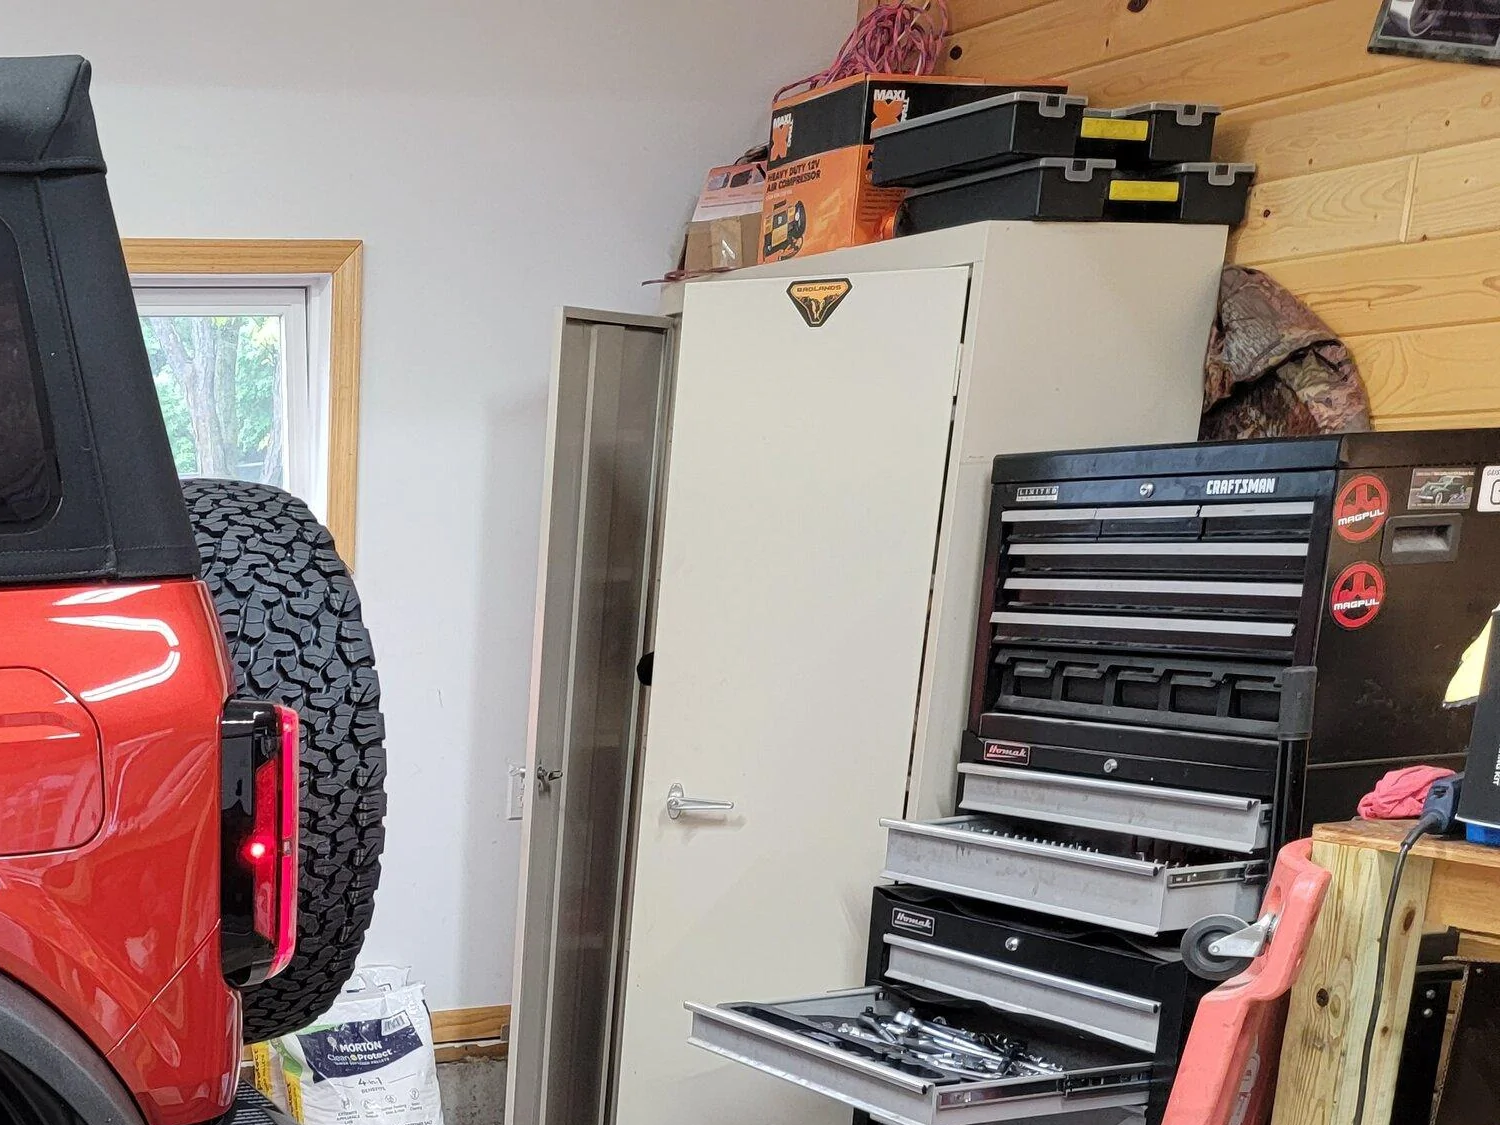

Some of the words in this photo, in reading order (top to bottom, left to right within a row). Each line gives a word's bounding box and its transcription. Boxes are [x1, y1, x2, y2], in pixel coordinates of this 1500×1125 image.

[873, 89, 906, 100] MAXI
[773, 113, 793, 126] MAXI
[778, 170, 821, 189] COMPRESSOR
[1018, 487, 1058, 496] LIMITED
[1206, 478, 1276, 495] CRAFTSMAN
[1337, 509, 1385, 526] MAGPUL
[1333, 598, 1380, 611] MAGPUL
[988, 744, 1027, 758] Homak
[339, 1040, 383, 1053] MORTON
[357, 1048, 393, 1061] Protect
